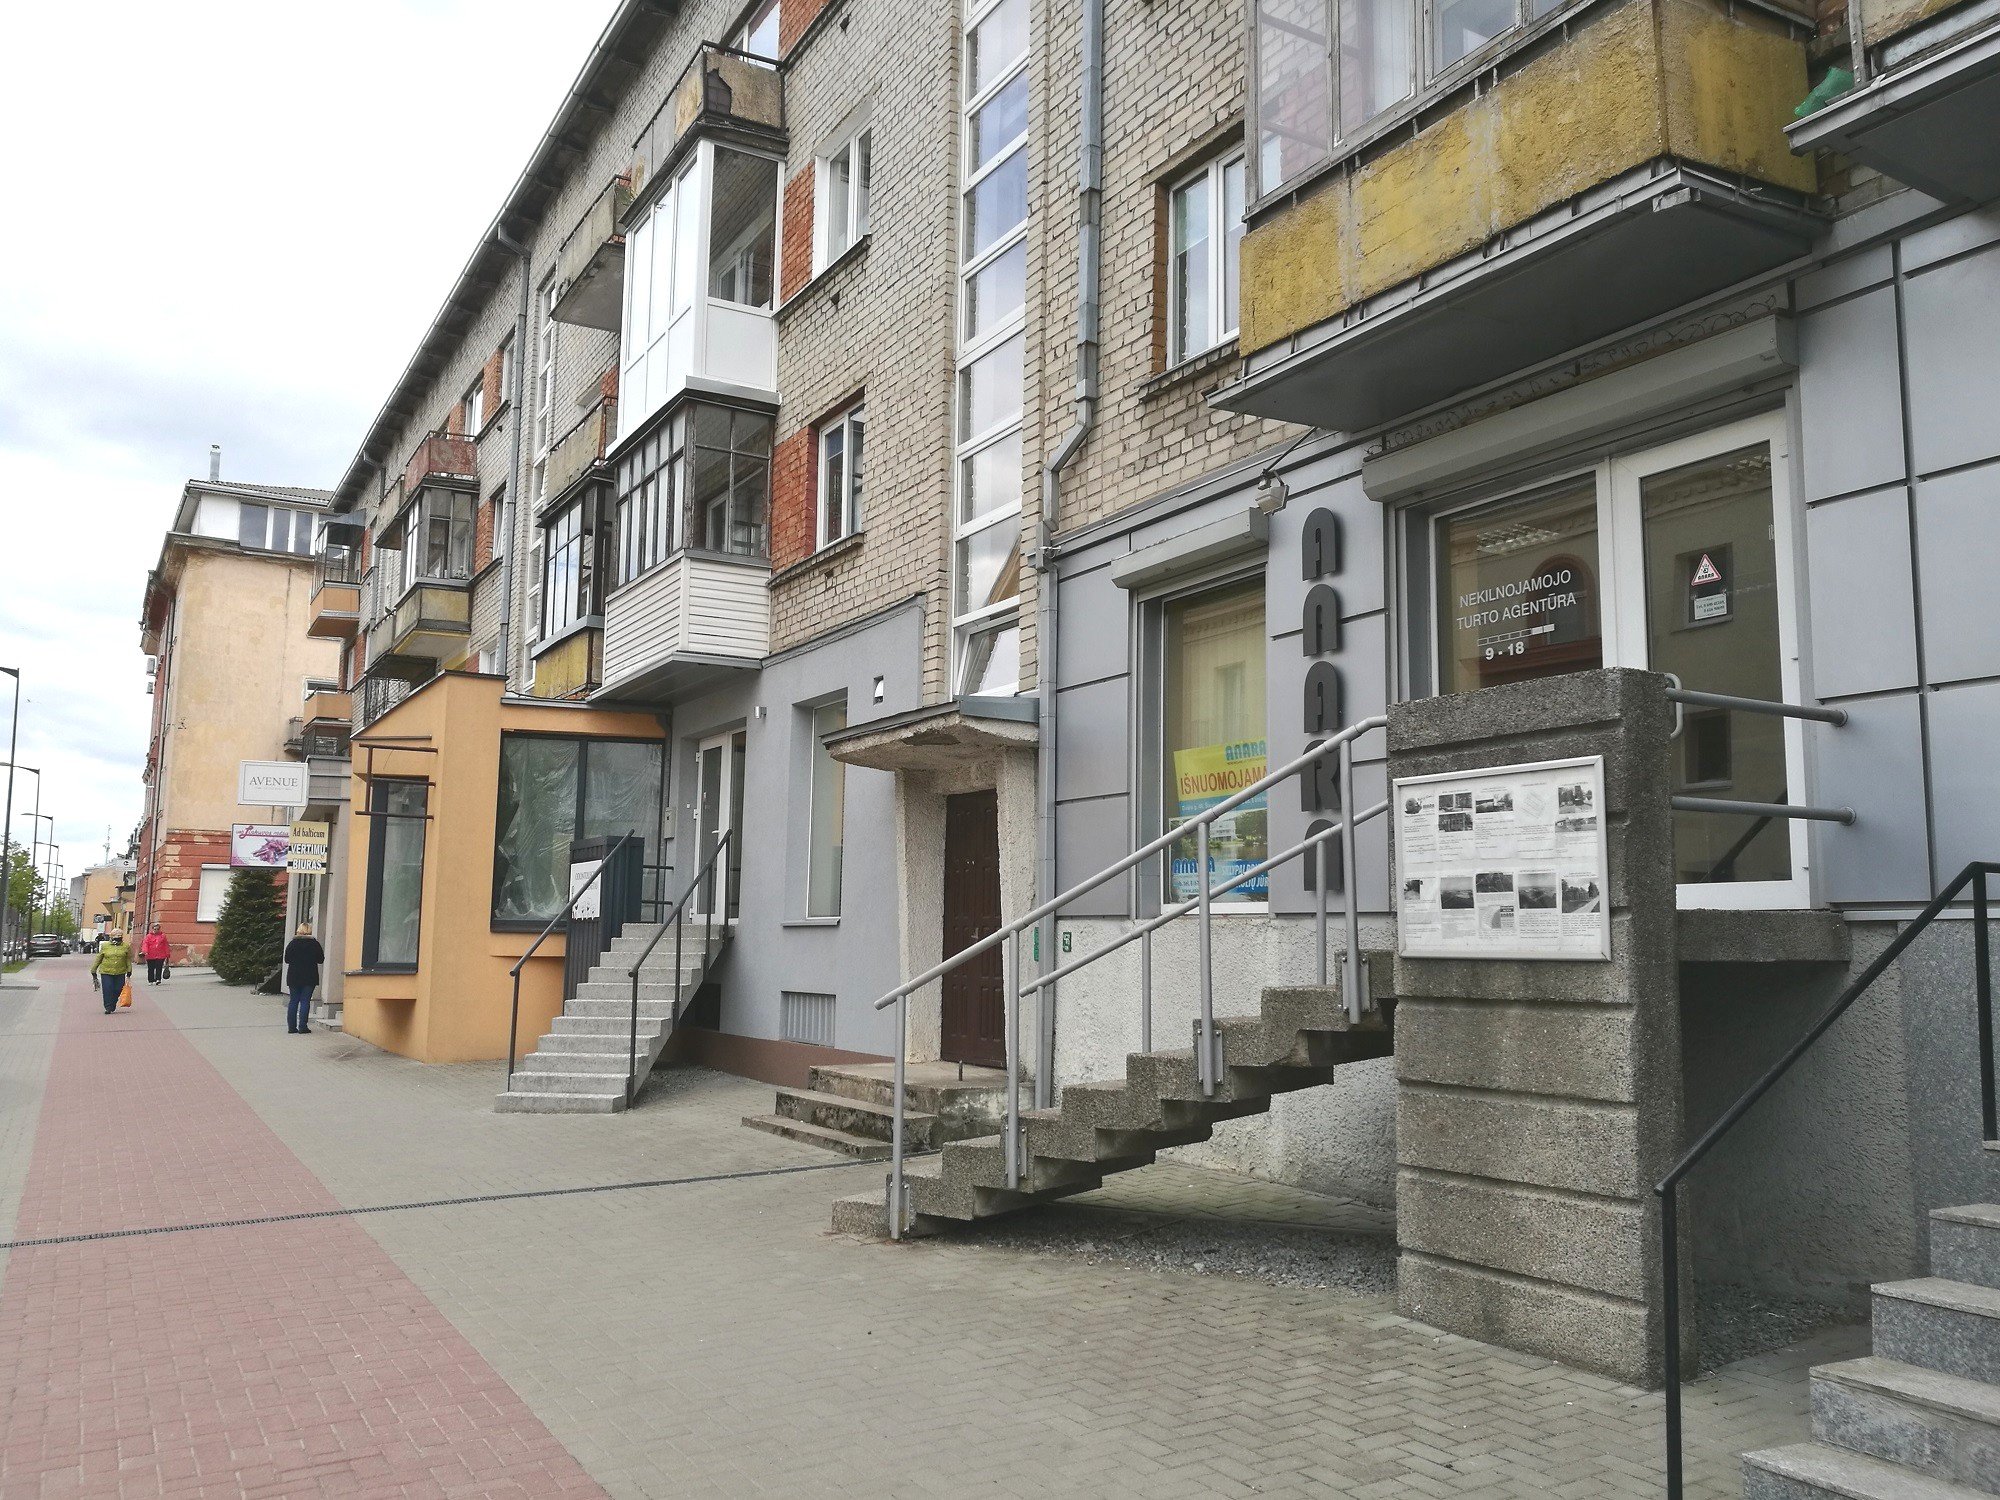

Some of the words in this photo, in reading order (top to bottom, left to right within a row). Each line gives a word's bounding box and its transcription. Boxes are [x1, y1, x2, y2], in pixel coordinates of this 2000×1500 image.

[1460, 569, 1571, 607] NEKILNOJAMOJO
[1457, 609, 1499, 630] TURTO
[1502, 592, 1577, 620] AGENTŪRA
[1485, 647, 1494, 661] 9
[1507, 641, 1525, 656] 18
[249, 776, 298, 787] AVENUE
[292, 827, 301, 837] Ad
[302, 827, 325, 838] balticum
[291, 843, 326, 859] VERTIMŲ
[292, 859, 322, 871] BIURAS
